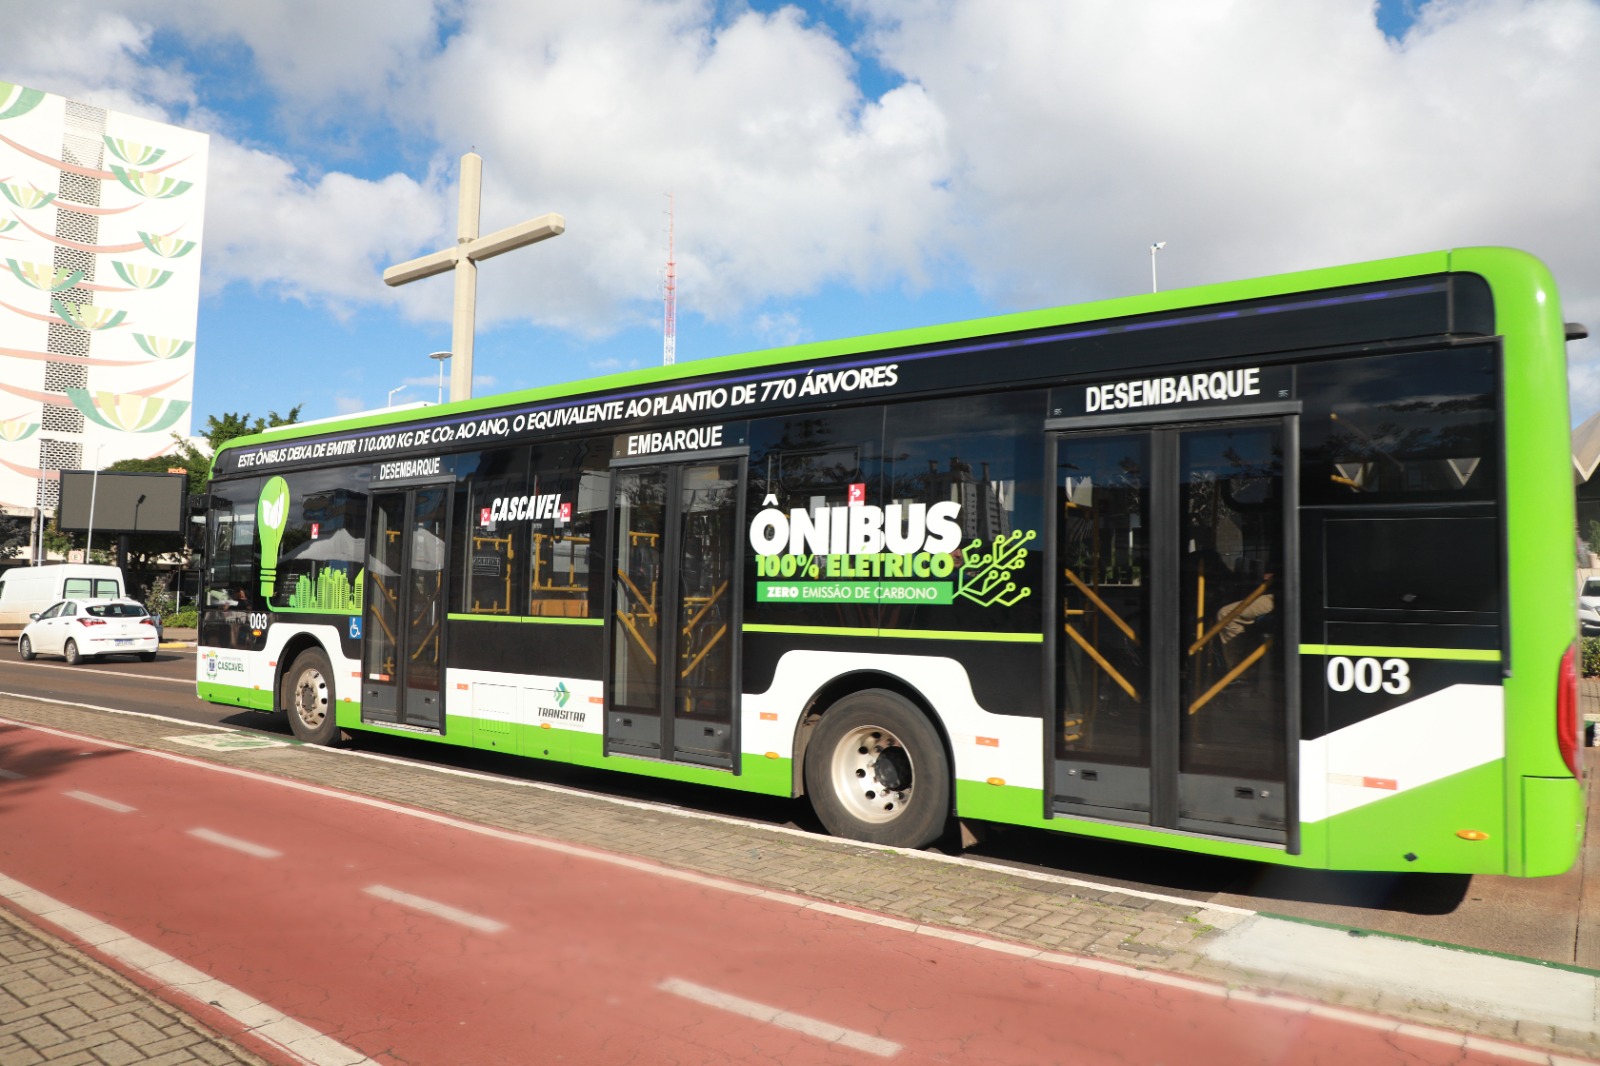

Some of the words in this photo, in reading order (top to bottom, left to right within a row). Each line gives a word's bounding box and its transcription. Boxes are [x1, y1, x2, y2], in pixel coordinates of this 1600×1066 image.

[1085, 367, 1261, 413] DESEMBARQUE
[237, 453, 256, 468] ESTE
[256, 448, 286, 465] ÔNIBUS
[287, 445, 312, 461] DEIXA
[312, 444, 326, 458] DE
[326, 441, 356, 456] EMITIR
[358, 434, 396, 452] 110.000
[397, 432, 413, 447] KG
[414, 429, 431, 446] DE
[455, 422, 476, 440] AO
[476, 418, 510, 437] ANO,
[513, 415, 526, 432] O
[527, 400, 624, 431] EQUIVALENTE
[625, 398, 652, 419] AO
[653, 387, 728, 416] PLANTIO
[730, 384, 757, 406] DE
[760, 378, 797, 402] 770
[798, 364, 899, 397] ÁRVORES
[627, 425, 724, 456] EMBARQUE
[379, 458, 441, 481] DESEMBARQUE
[490, 493, 562, 522] CASCAVEL
[749, 493, 963, 556] ÔNIBUS
[755, 553, 820, 579] 100%
[826, 546, 955, 579] ELÉTRICO
[766, 586, 799, 599] ZERO
[802, 584, 852, 599] EMISSÃO
[855, 587, 871, 600] DE
[874, 587, 938, 601] CARBONO
[250, 613, 268, 630] 003
[217, 661, 245, 673] CASCAVEL
[1327, 656, 1411, 696] 003
[537, 706, 587, 723] TRANSITAR
